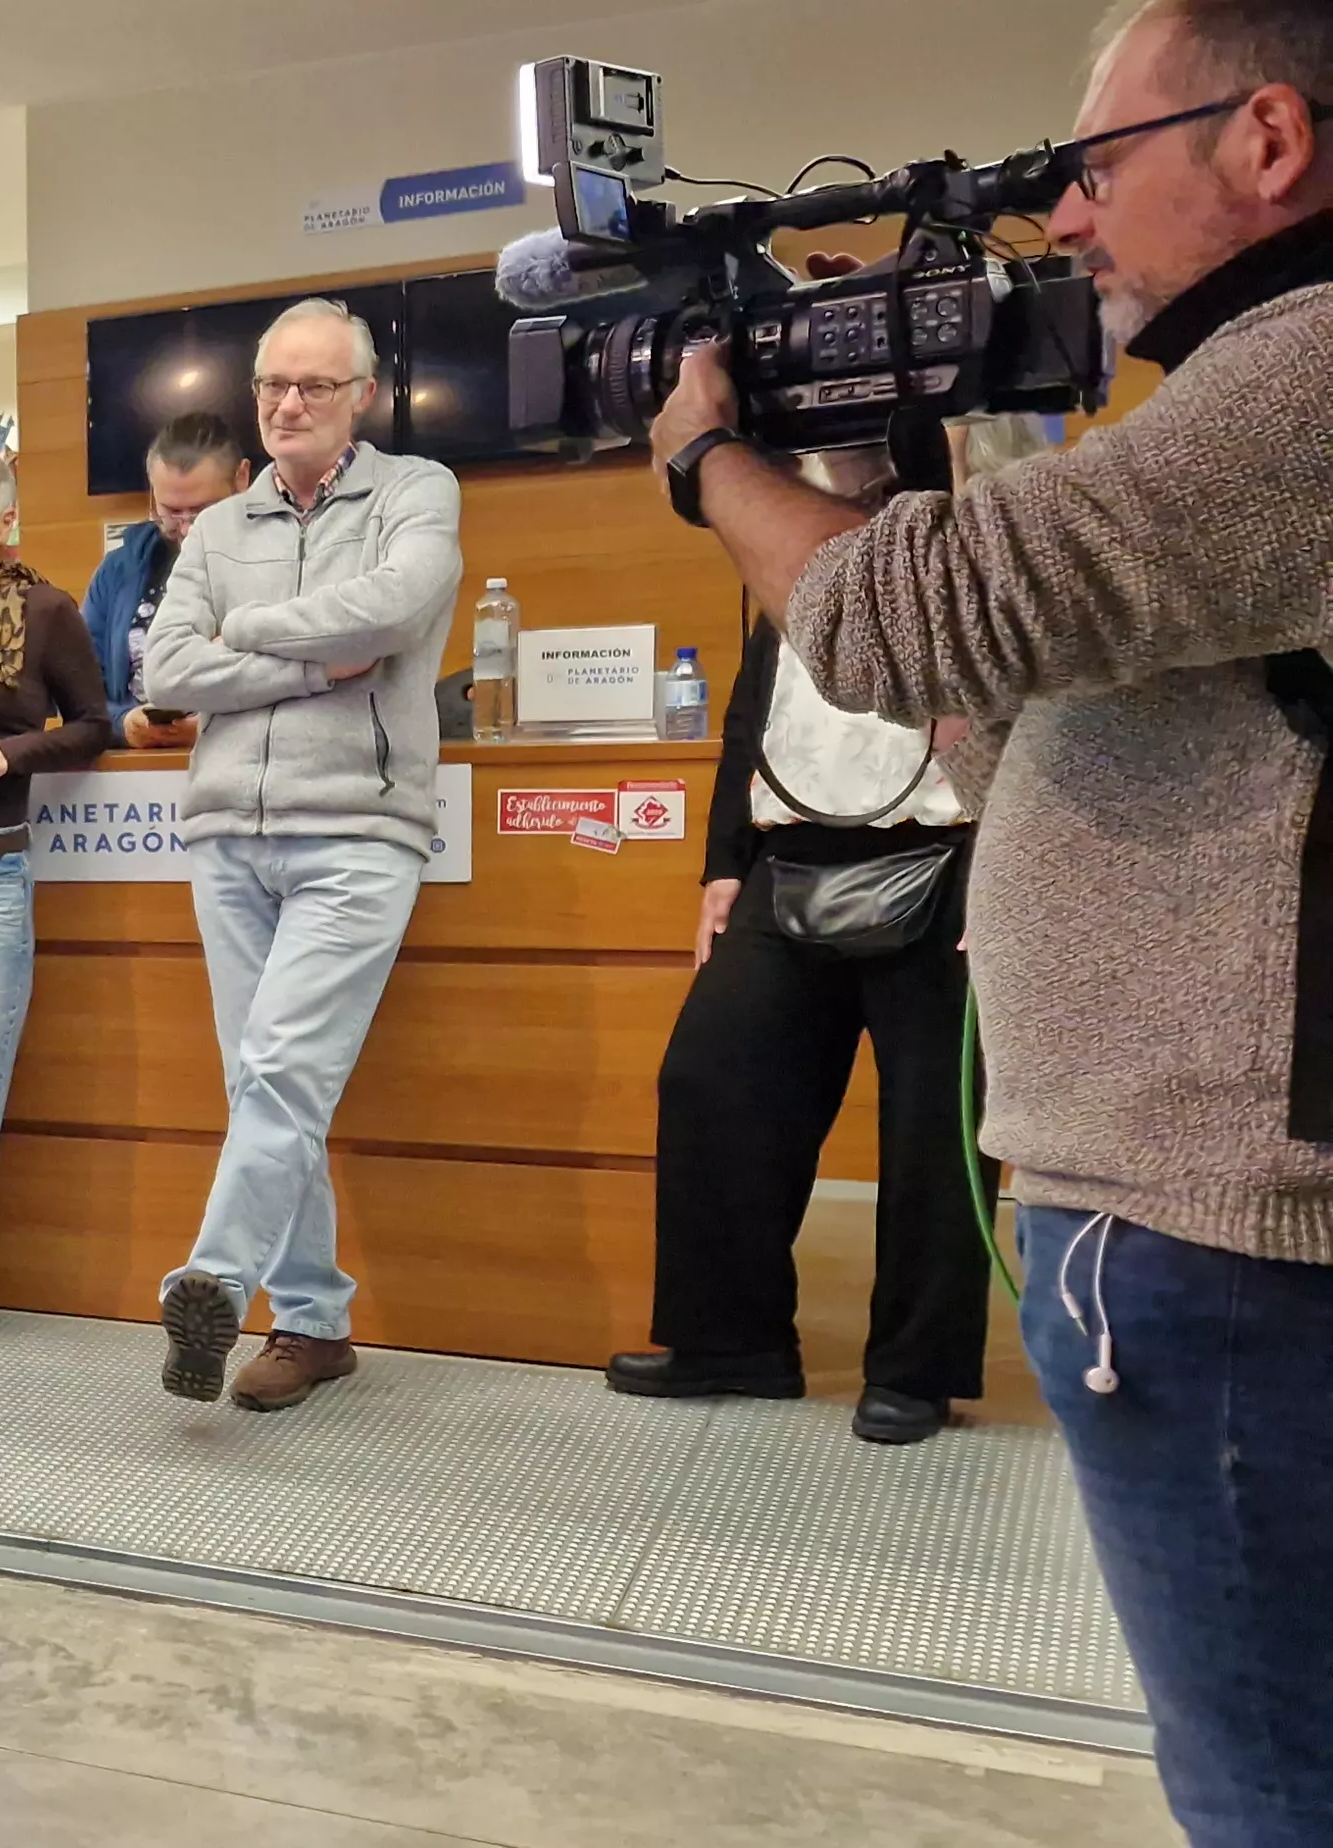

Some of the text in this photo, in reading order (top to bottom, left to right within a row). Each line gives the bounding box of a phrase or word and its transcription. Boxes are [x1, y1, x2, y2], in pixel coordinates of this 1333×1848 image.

[398, 180, 505, 208] INFORMACIÓN
[912, 264, 971, 279] SONY
[541, 647, 631, 660] INFORMACIÓN
[567, 666, 640, 676] PLANETARIO
[567, 675, 634, 685] DE ARAGÓN
[506, 795, 607, 812] Establecimiento
[36, 802, 176, 824] ANETARI
[506, 811, 564, 829] adherido
[49, 825, 188, 853] ARAGÓN
